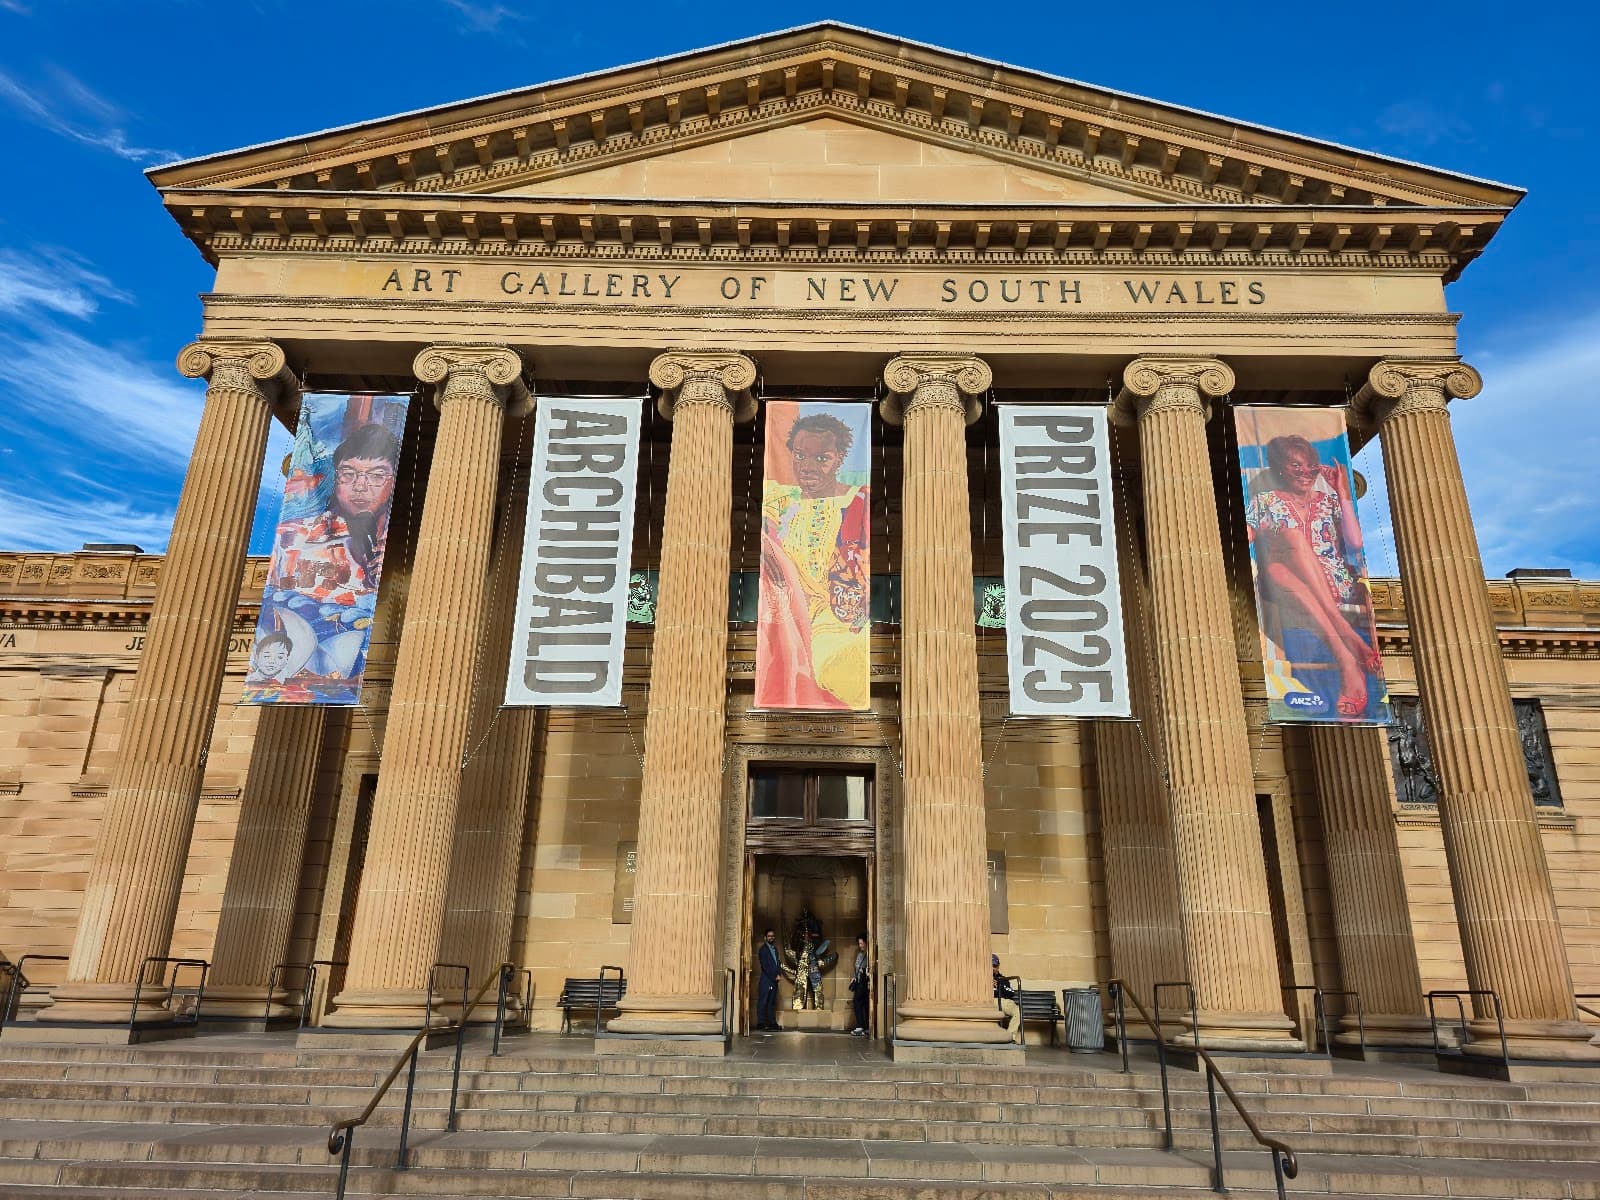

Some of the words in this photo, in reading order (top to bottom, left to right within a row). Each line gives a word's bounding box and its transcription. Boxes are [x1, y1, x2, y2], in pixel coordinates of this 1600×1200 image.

[382, 269, 462, 293] ART
[500, 271, 681, 299] GALLERY
[720, 276, 767, 300] OF
[806, 276, 899, 302] NEW
[941, 278, 1082, 304] SOUTH
[1123, 280, 1266, 305] WALES
[1013, 415, 1103, 548] PRIZE
[523, 408, 628, 694] ARCHIBALD
[1019, 564, 1114, 704] 2025
